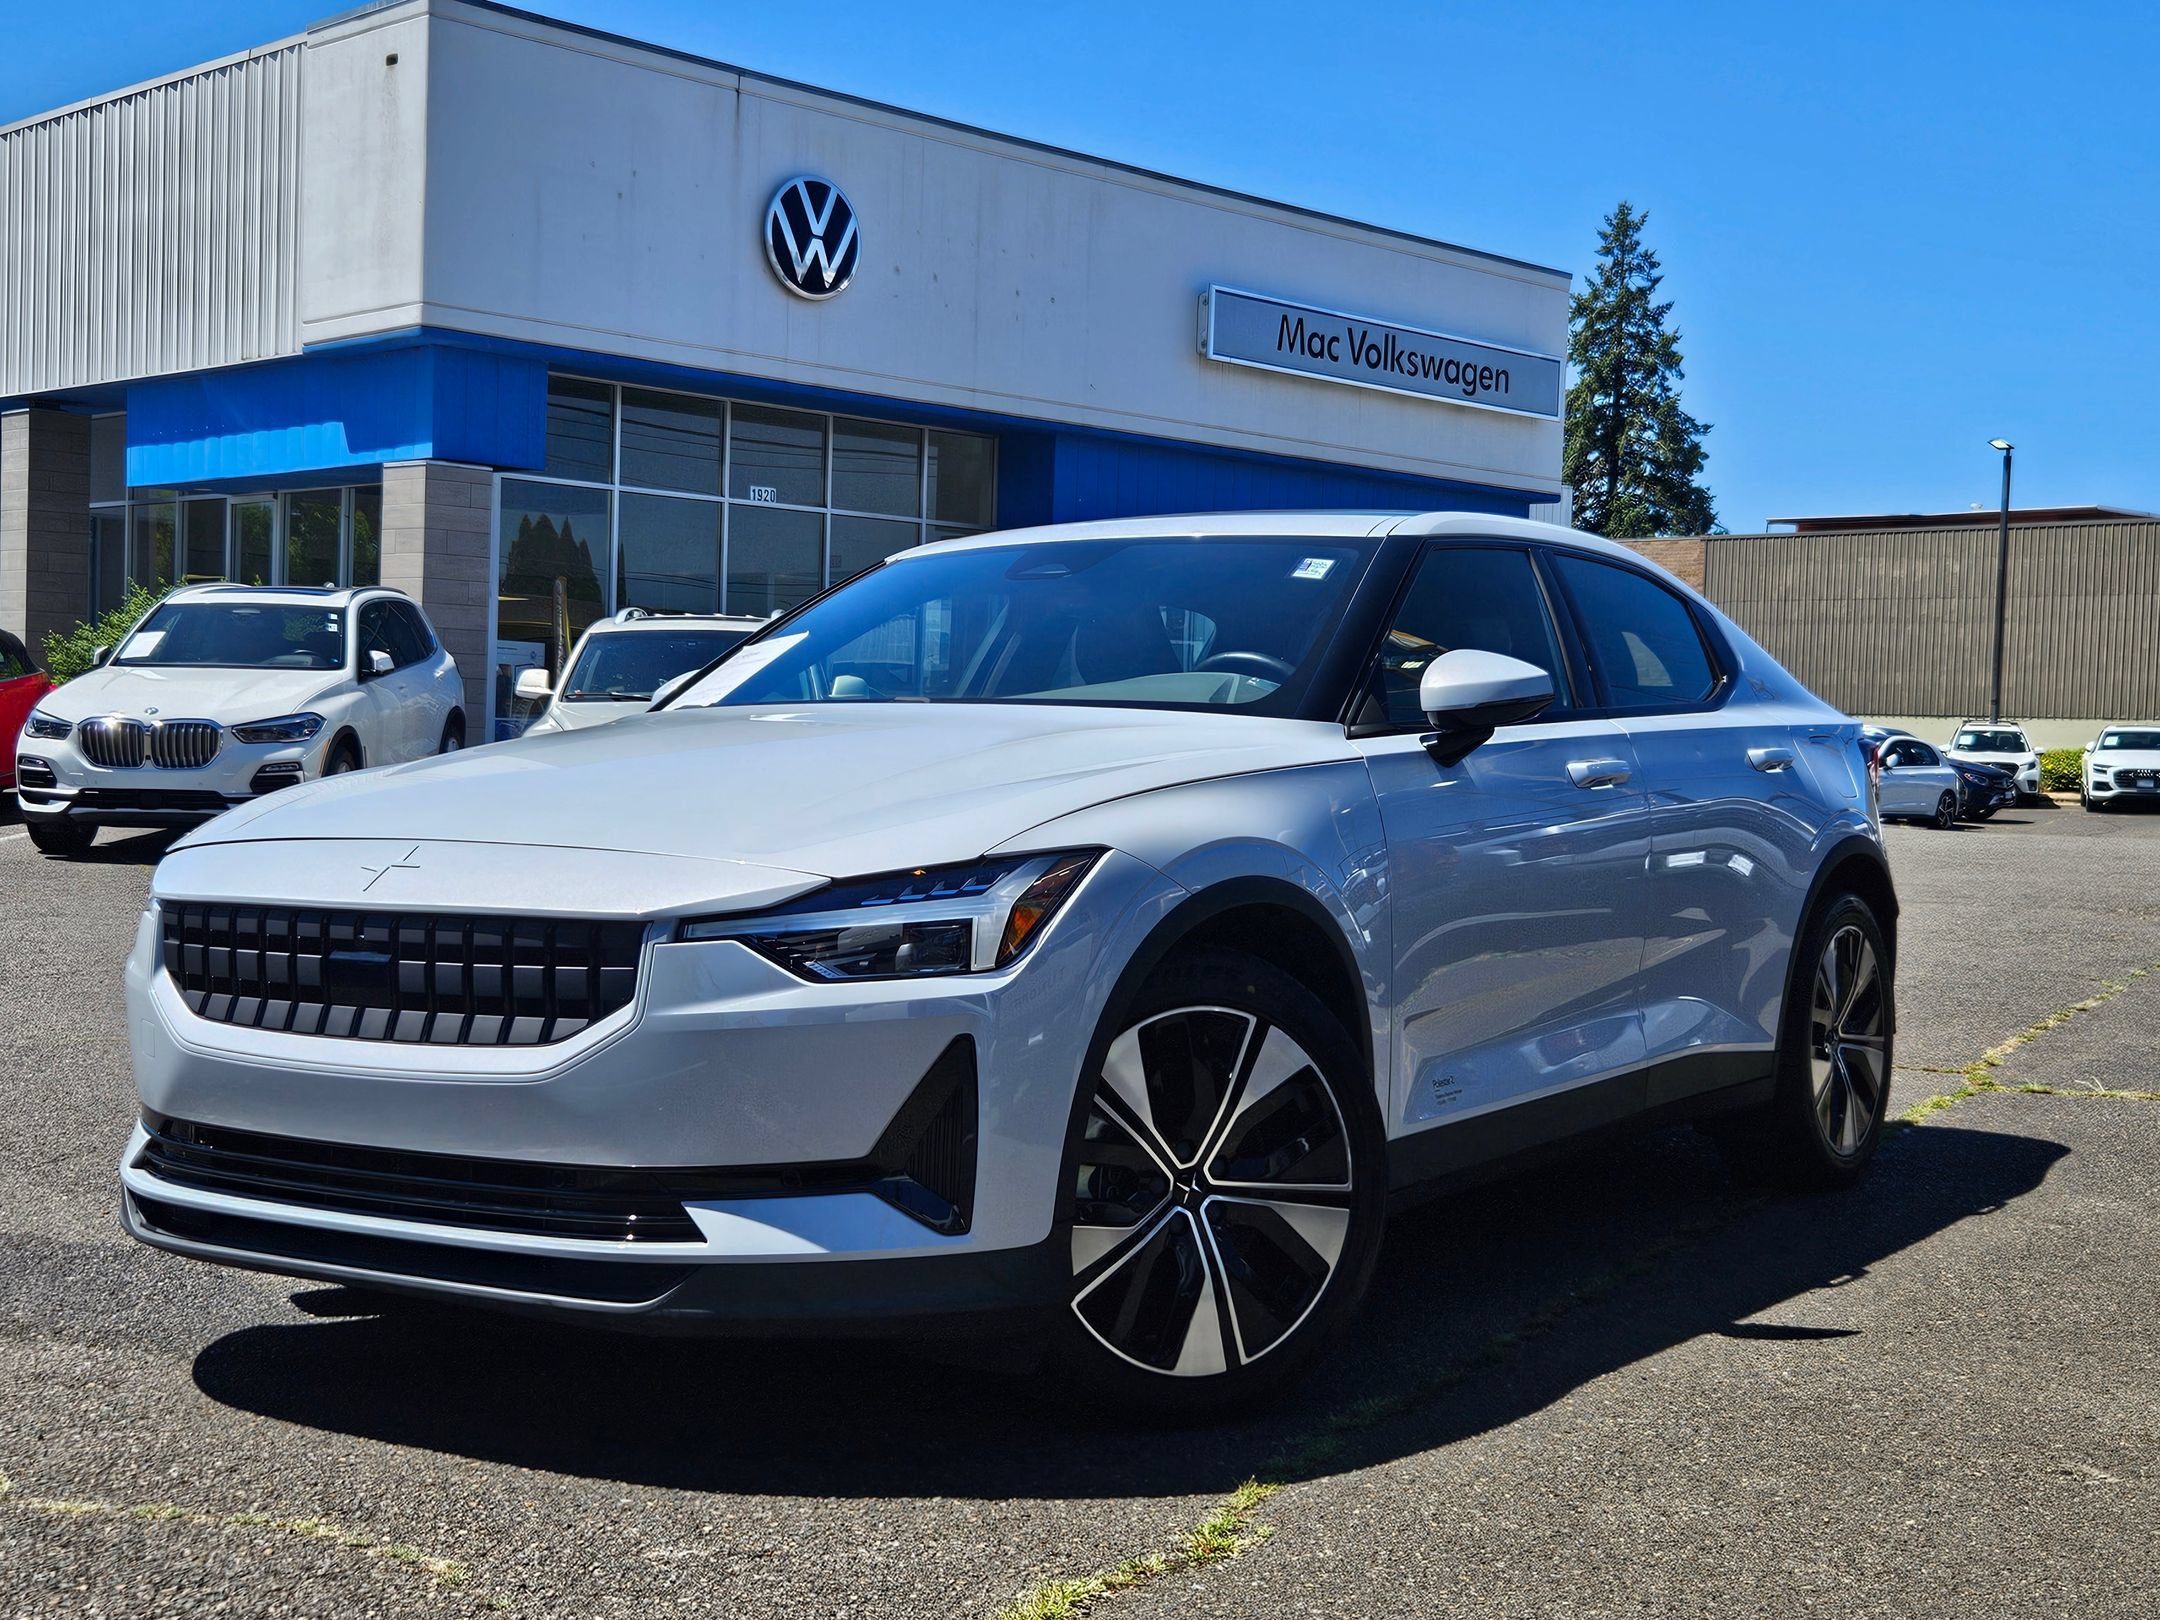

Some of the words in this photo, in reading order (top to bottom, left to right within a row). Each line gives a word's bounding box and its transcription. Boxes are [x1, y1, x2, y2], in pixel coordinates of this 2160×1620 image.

[767, 176, 860, 293] VW
[1276, 314, 1340, 363] Mac
[1347, 327, 1509, 397] Volkswagen
[752, 488, 776, 503] 1920
